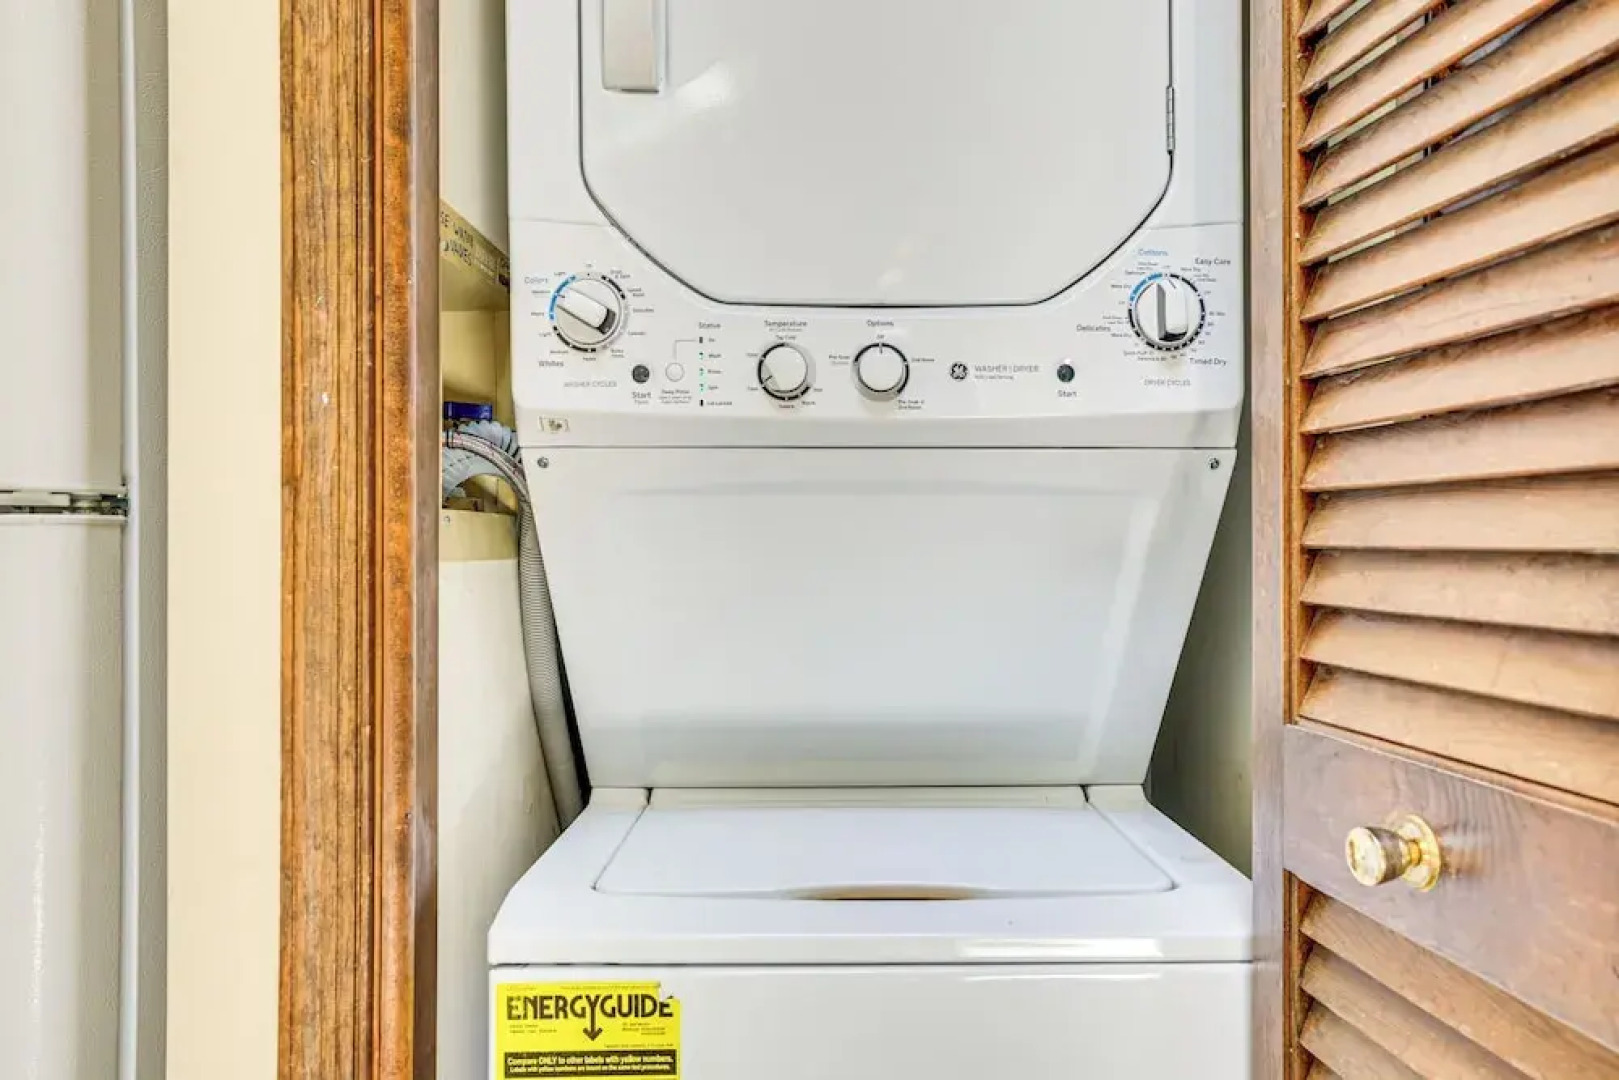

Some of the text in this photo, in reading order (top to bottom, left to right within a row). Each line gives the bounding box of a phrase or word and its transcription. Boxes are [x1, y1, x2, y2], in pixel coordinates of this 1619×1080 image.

[1195, 257, 1231, 266] Easy Care
[524, 276, 548, 284] Colors
[699, 321, 721, 329] Status
[764, 319, 807, 328] Temperature
[866, 319, 894, 327] Options
[1076, 324, 1111, 332] Delicates
[1190, 357, 1227, 366] Timed Dry
[632, 391, 651, 399] Start
[1057, 389, 1077, 397] Start
[507, 994, 673, 1020] ENERGYGUIDE
[507, 1056, 536, 1067] Compare
[538, 1056, 557, 1065] ONLY
[558, 1056, 565, 1064] to
[566, 1056, 584, 1064] other
[584, 1054, 604, 1064] labels
[605, 1054, 620, 1063] with
[620, 1054, 642, 1064] yellow
